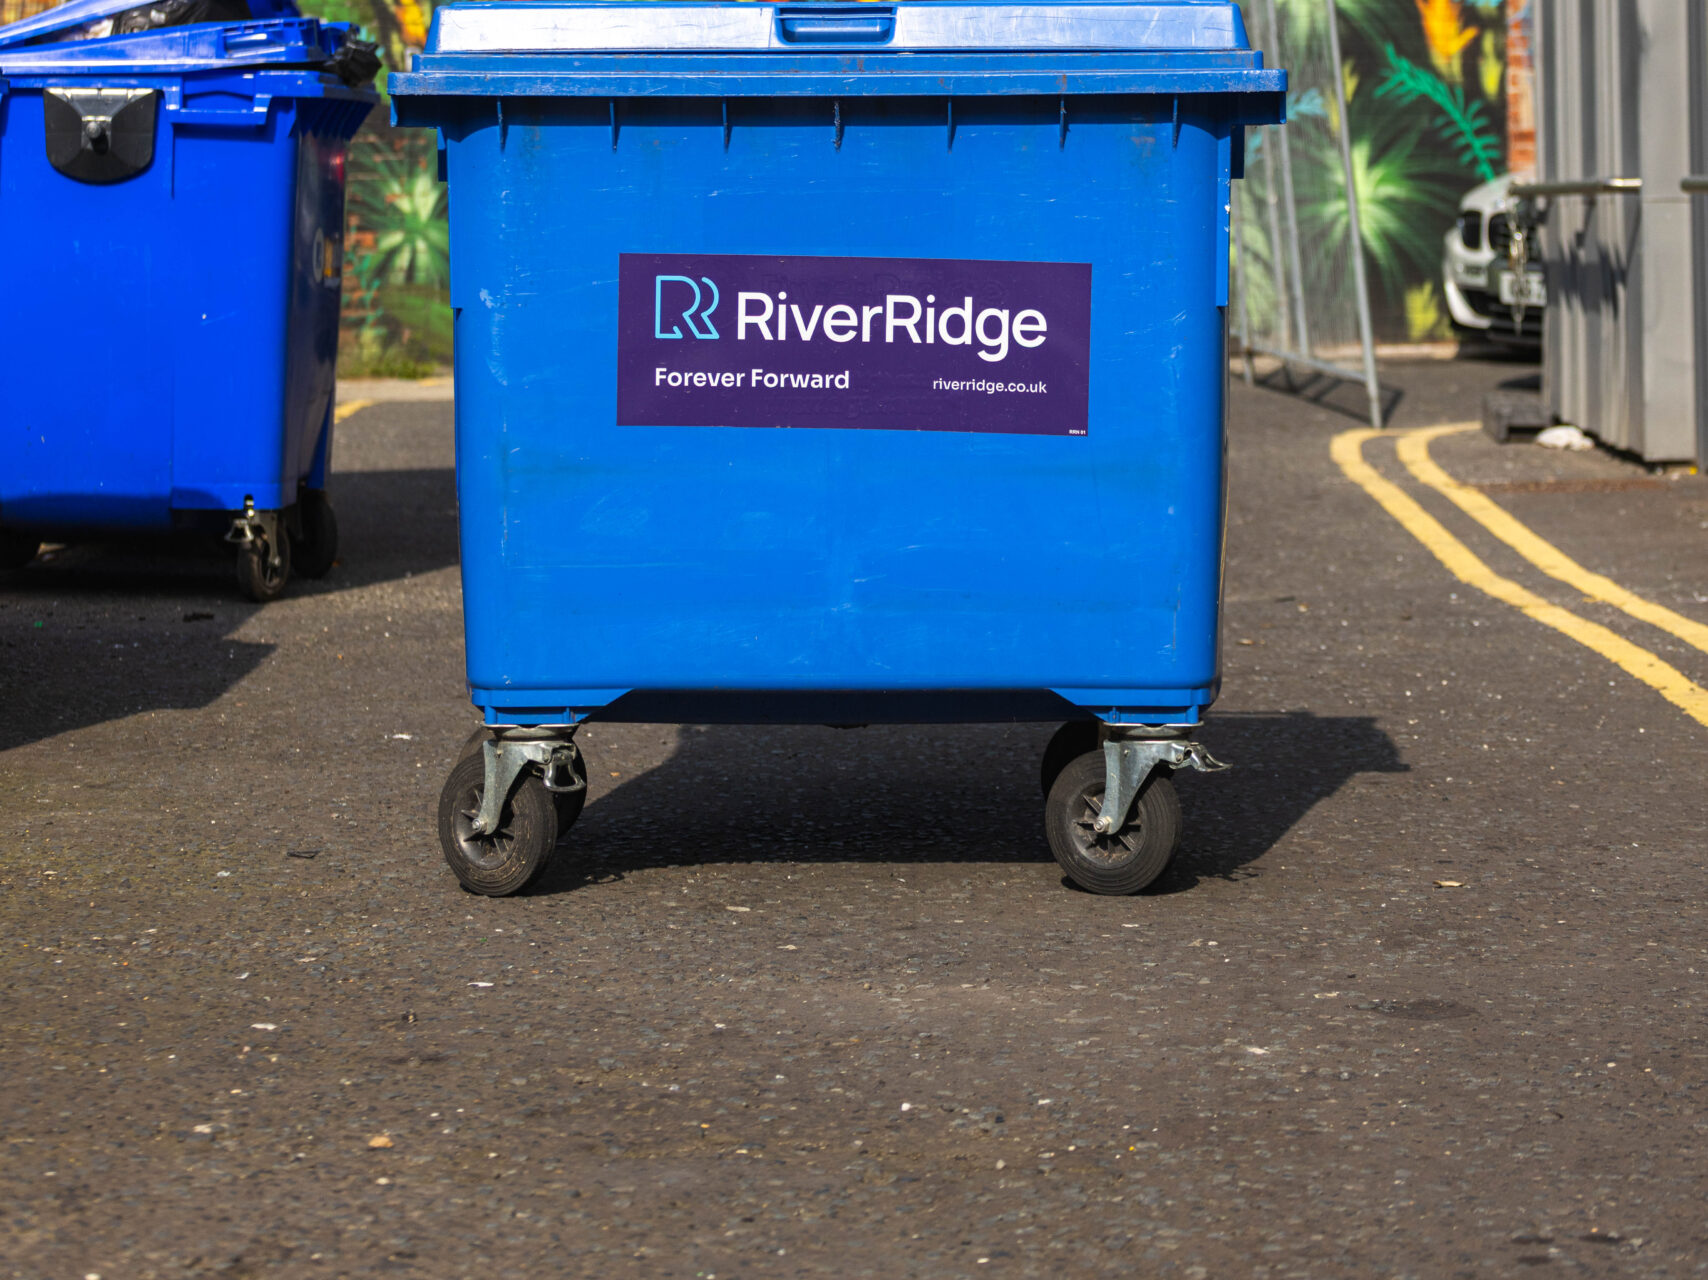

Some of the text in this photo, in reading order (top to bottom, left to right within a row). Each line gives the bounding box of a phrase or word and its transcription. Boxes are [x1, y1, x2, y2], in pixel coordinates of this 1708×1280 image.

[737, 291, 1048, 362] RiverRidge
[655, 368, 850, 390] Forever Forward
[932, 377, 1048, 395] riverridge.co.uk
